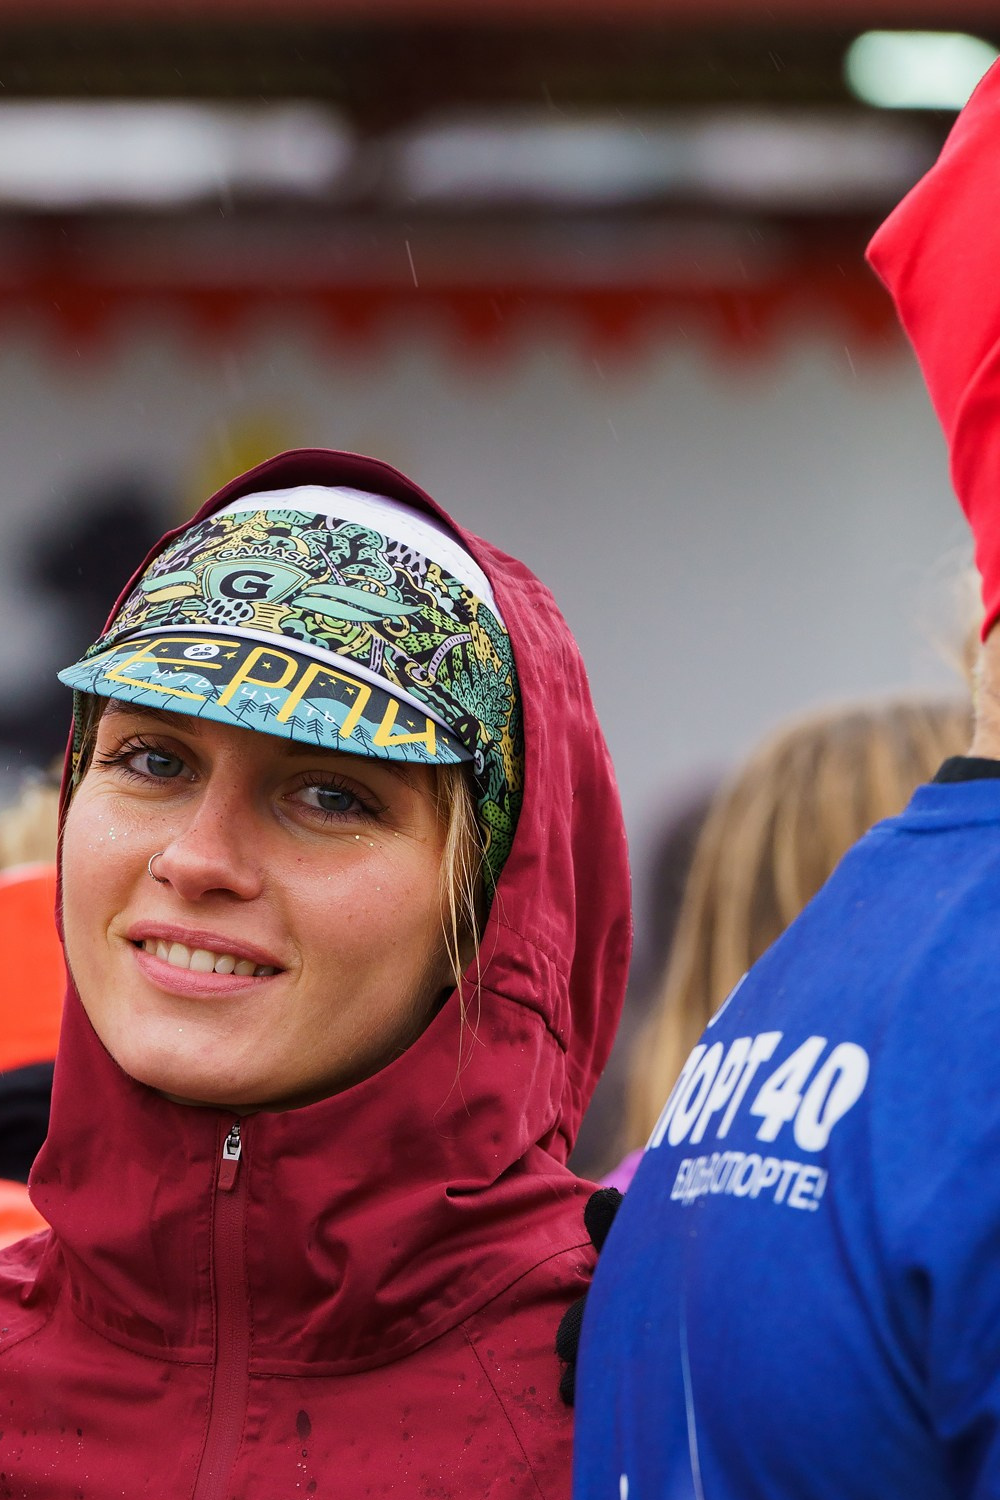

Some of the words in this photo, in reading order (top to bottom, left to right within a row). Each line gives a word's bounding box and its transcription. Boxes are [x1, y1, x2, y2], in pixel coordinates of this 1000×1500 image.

[217, 545, 318, 570] GAMASH
[219, 570, 275, 599] G
[751, 1035, 870, 1152] 40
